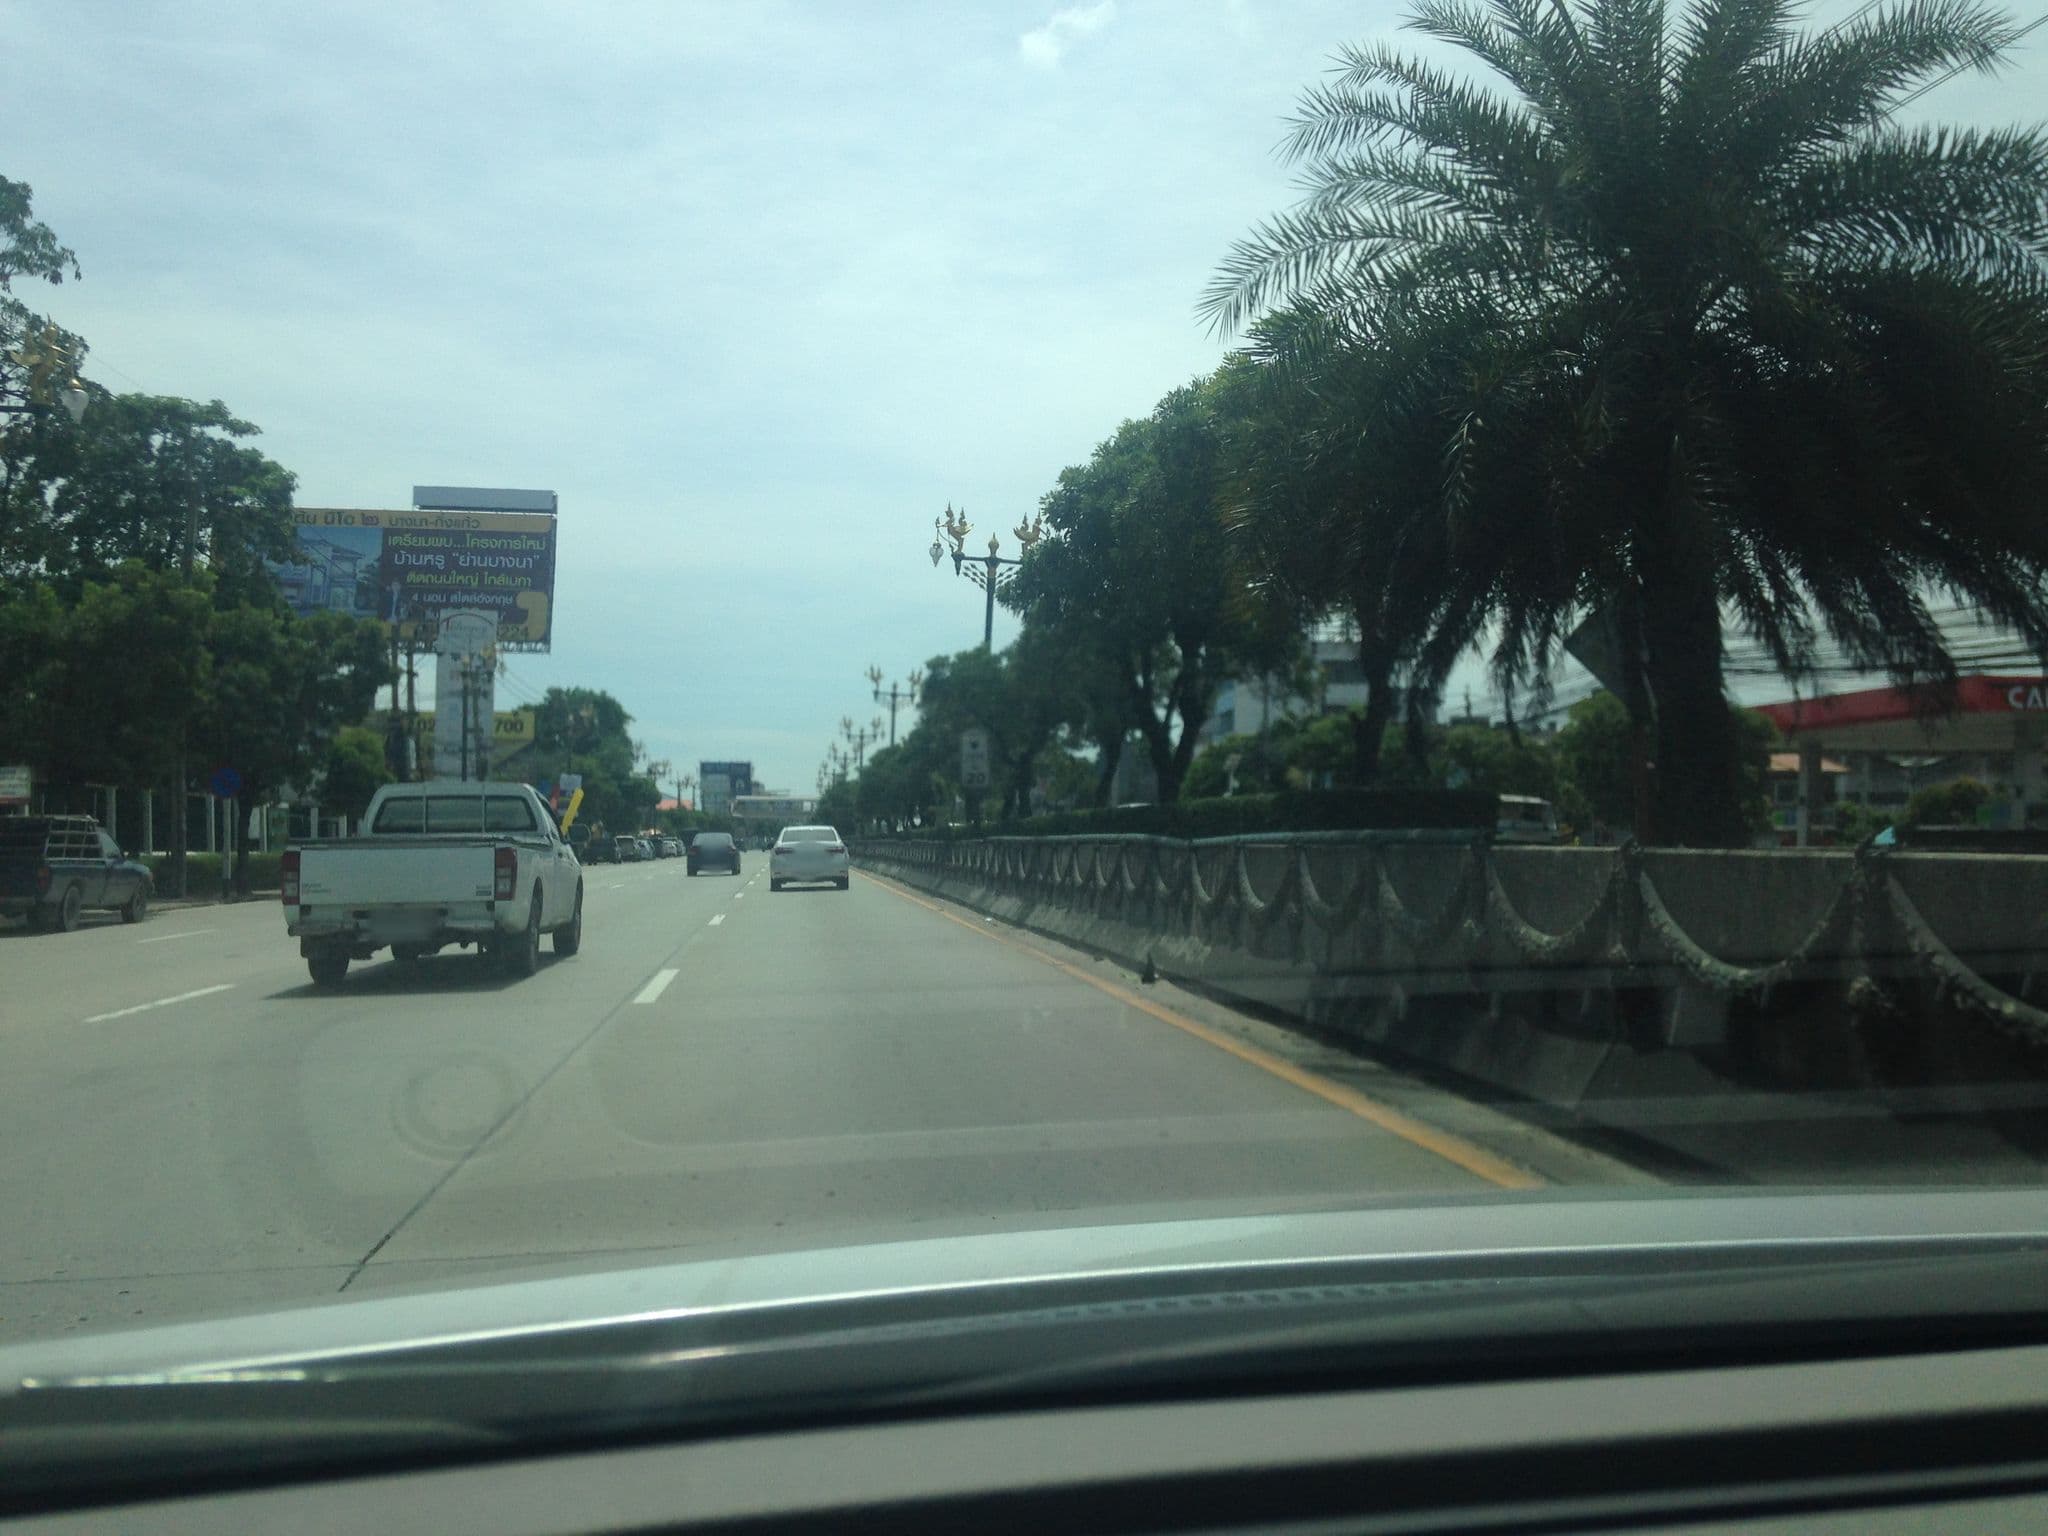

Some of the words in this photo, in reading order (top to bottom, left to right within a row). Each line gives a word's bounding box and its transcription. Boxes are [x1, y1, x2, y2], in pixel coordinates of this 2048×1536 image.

[394, 550, 446, 570] บ้านหรู
[406, 570, 479, 587] ติดถนนใหญ่
